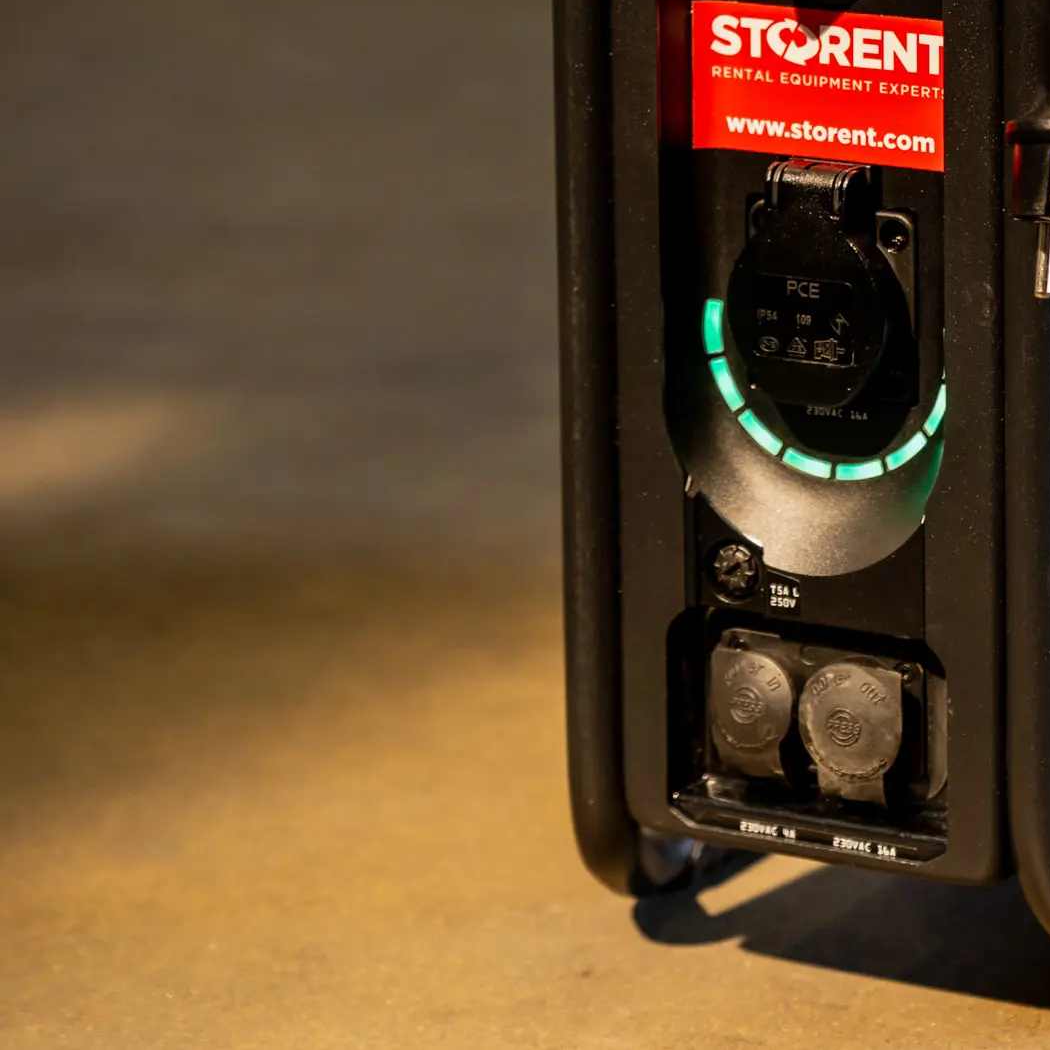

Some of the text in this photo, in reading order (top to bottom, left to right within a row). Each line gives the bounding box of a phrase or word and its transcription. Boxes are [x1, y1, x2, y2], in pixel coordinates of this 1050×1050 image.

[710, 15, 944, 75] STORENT
[712, 66, 774, 83] RENTAL
[780, 72, 873, 93] EQUIPMENT
[726, 116, 936, 153] www.storent.com
[786, 280, 820, 299] PCE
[832, 837, 871, 853] 230VAC
